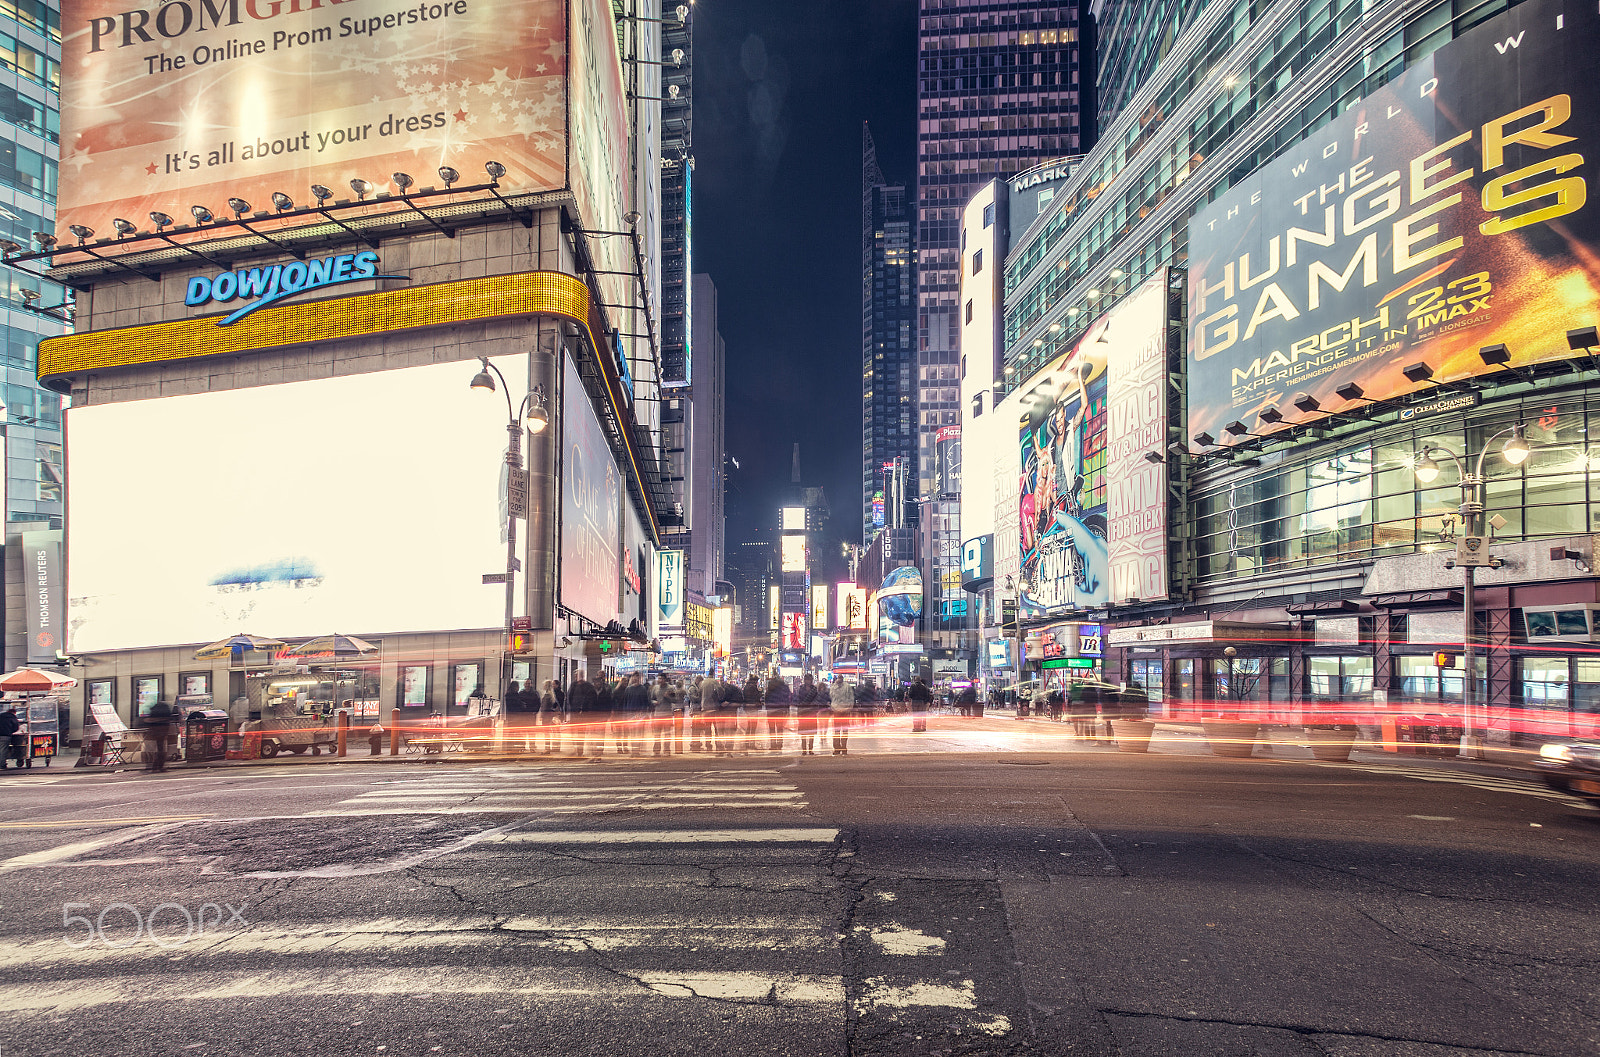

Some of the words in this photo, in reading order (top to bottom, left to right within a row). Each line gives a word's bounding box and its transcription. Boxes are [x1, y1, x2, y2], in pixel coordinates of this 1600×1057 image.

[144, 53, 186, 75] The
[192, 39, 266, 65] Online
[273, 26, 332, 50] Prom
[339, 0, 467, 38] Superstore
[165, 151, 200, 174] It's
[207, 142, 234, 166] all
[241, 131, 310, 160] about
[317, 122, 372, 153] your
[379, 111, 446, 137] dress
[1207, 189, 1262, 232] THE
[1291, 77, 1438, 179] WORLD
[1196, 94, 1579, 316] HUNGER
[1293, 155, 1375, 215] THE
[1194, 153, 1587, 361] GAMES
[1232, 306, 1389, 387] MARCH
[1407, 271, 1492, 320] 23
[1232, 346, 1348, 398] EXPERIENCE
[1356, 336, 1376, 352] IT
[1384, 325, 1407, 342] IN
[1418, 296, 1492, 330] IMAX
[1440, 314, 1492, 332] LIONSGATE
[1286, 342, 1400, 387] THEHUNGERGAMESMOVIE.COM
[571, 443, 599, 526] GAME
[37, 550, 48, 586] REUTERS
[584, 519, 616, 596] THRONES
[884, 529, 892, 558] 1500
[38, 587, 50, 629] THOMSON
[665, 554, 673, 604] NYPD
[33, 736, 53, 746] NUTS
[35, 747, 54, 757] NUTS
